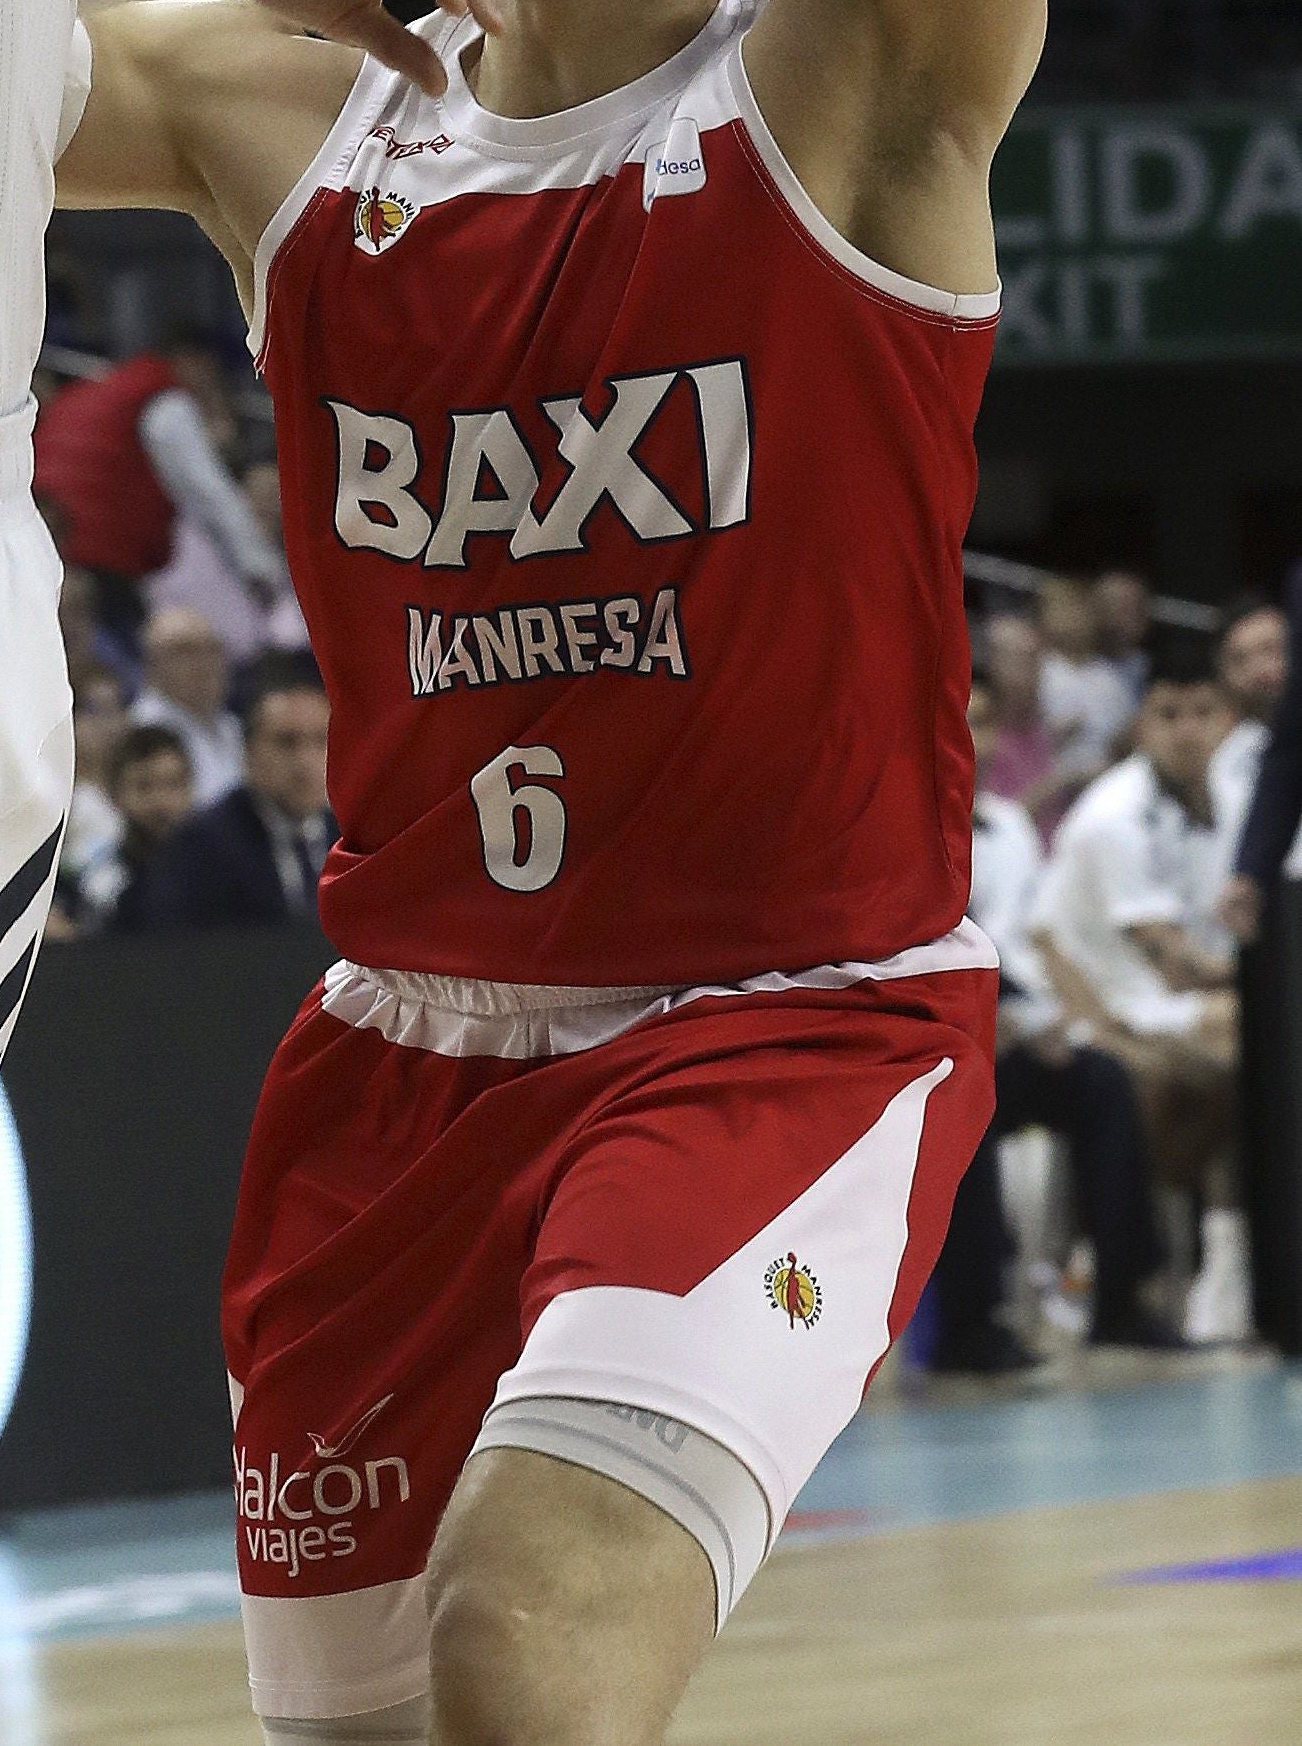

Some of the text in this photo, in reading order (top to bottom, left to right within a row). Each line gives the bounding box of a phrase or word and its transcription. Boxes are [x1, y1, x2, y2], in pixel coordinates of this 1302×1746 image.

[325, 359, 752, 567] BAXI
[406, 589, 688, 697] MANRESA
[469, 744, 566, 893] 6
[246, 1521, 357, 1578] viajes
